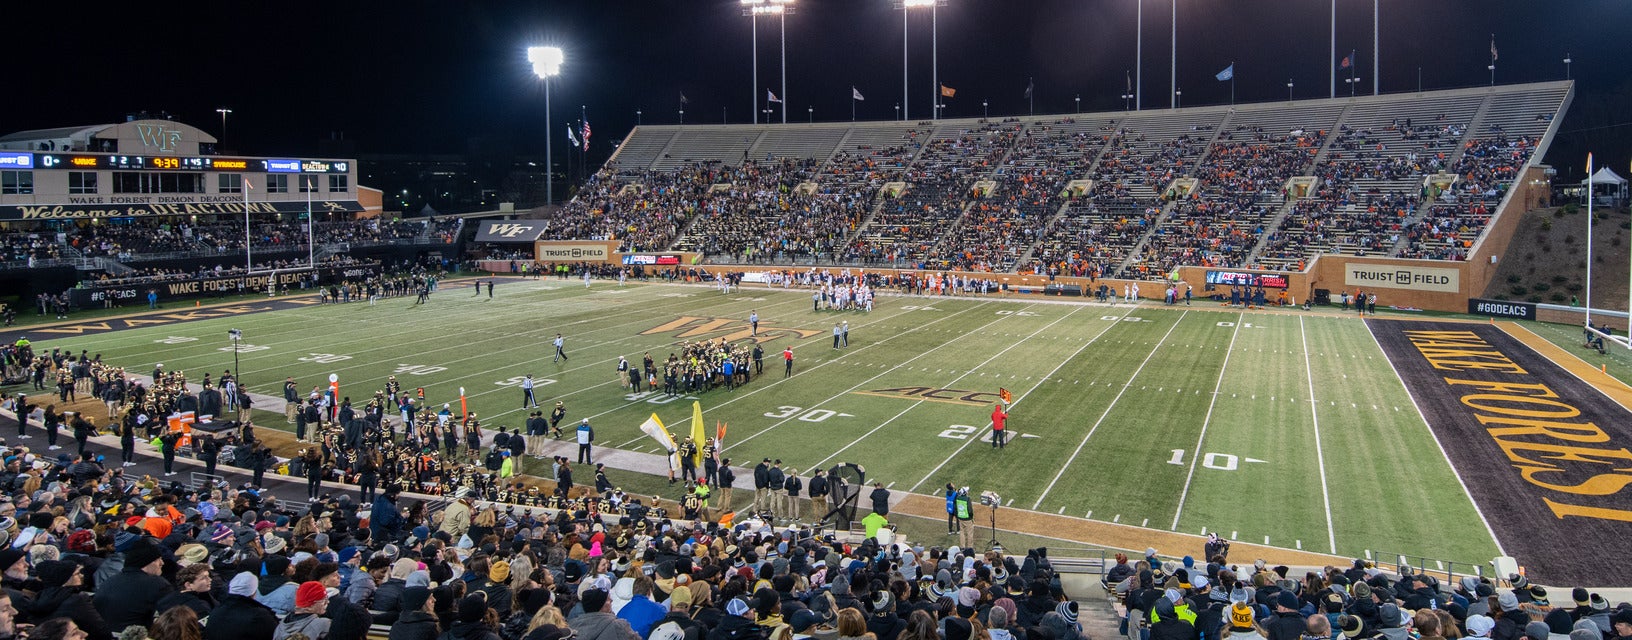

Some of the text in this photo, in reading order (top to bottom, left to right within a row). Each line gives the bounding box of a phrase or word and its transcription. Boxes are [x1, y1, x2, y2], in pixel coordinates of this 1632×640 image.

[137, 124, 182, 152] WF
[120, 156, 128, 165] 2
[136, 156, 142, 165] 7
[153, 158, 179, 168] 9:39
[213, 161, 247, 169] SYRACUSE
[261, 160, 268, 170] 7
[334, 162, 347, 172] 40
[110, 196, 152, 204] FOREST
[158, 196, 195, 204] DEMON
[200, 195, 244, 203] DEACONS
[16, 202, 279, 220] Welcome to DEACTOWN
[488, 223, 534, 238] WF
[1353, 270, 1450, 285] TRUIST FIELD
[91, 289, 137, 301] #GEACS
[169, 281, 200, 295] WAKE
[1477, 302, 1527, 316] #GODEACS
[28, 304, 273, 334] WAKE
[1402, 330, 1529, 375] WAKE
[870, 386, 1003, 404] ACC
[763, 405, 837, 422] 30
[938, 424, 1018, 444] 20
[1166, 449, 1239, 471] 10
[598, 502, 609, 513] 93
[685, 497, 698, 509] 40
